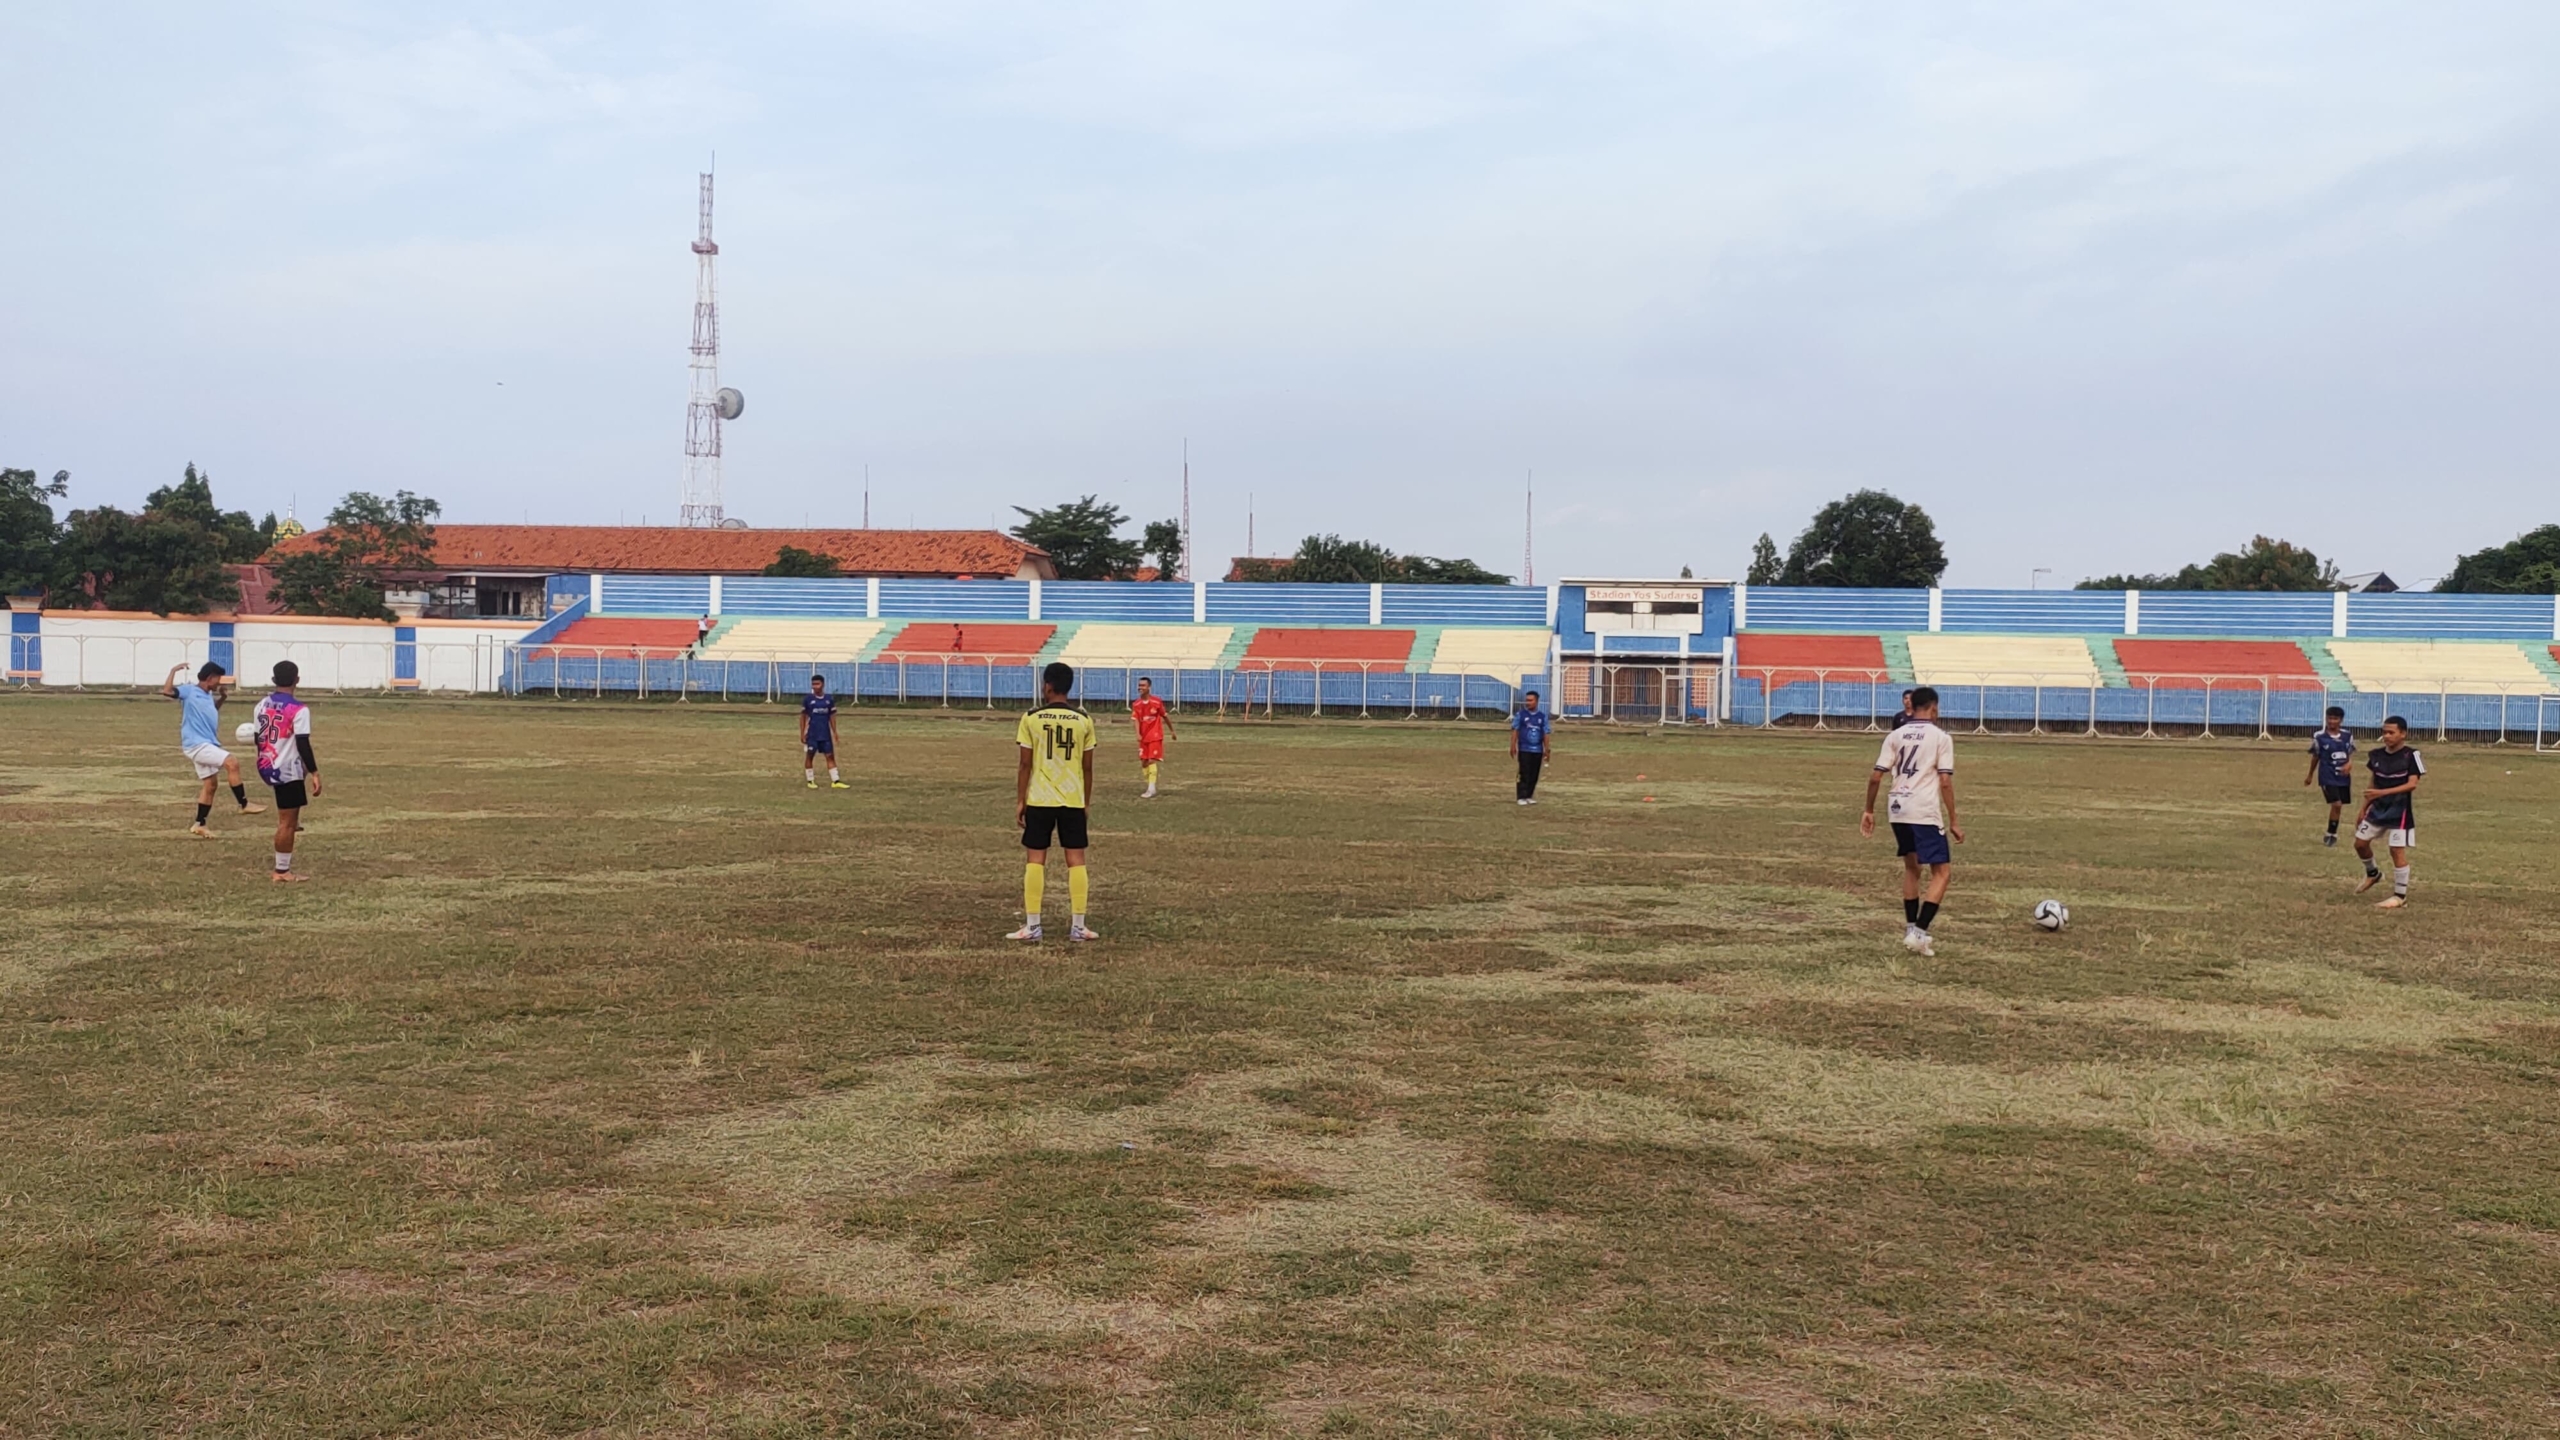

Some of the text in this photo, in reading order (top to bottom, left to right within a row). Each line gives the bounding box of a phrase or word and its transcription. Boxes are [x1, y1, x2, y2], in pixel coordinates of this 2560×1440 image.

[1590, 590, 1698, 600] Stadion Yos Sudarso
[258, 714, 283, 745] 26
[1043, 724, 1075, 761] 14
[1895, 744, 1920, 779] 14
